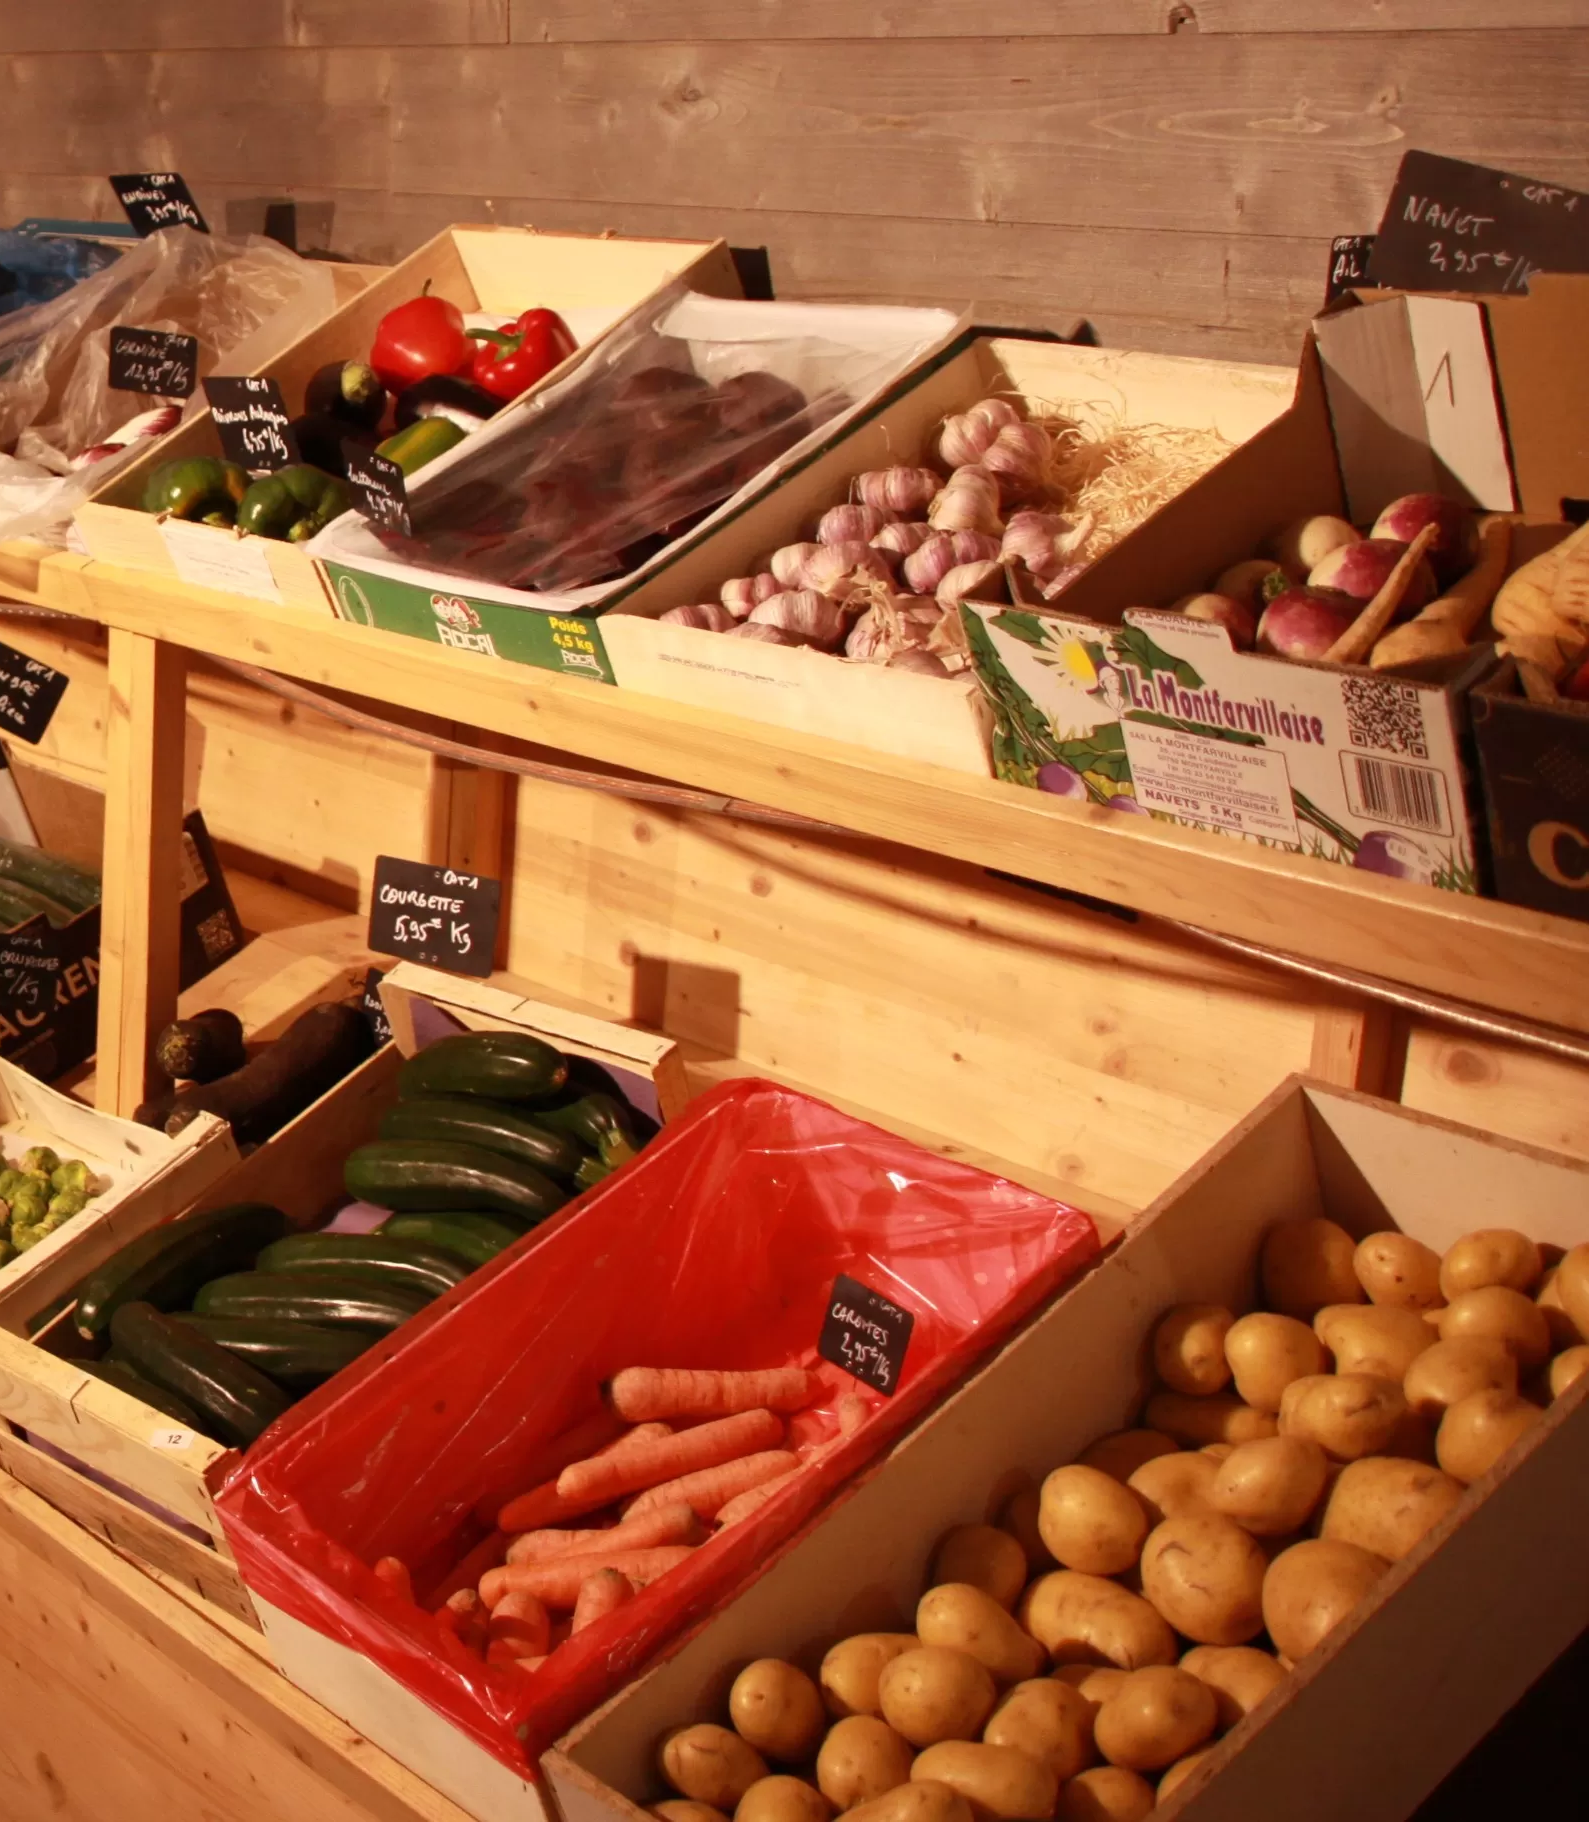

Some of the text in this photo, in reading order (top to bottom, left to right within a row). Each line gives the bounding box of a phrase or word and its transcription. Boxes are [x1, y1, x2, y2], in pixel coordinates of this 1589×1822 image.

[1403, 195, 1496, 238] NAVET
[548, 615, 588, 636] Poids
[552, 632, 595, 654] 4,5 kg
[1125, 667, 1325, 746] La Montfarvillaise
[1143, 788, 1201, 811] NAVETS
[1208, 803, 1219, 815] 5
[1221, 806, 1242, 822] Kg
[380, 884, 464, 913] COURGETTE
[451, 921, 472, 954] Kg
[167, 1434, 183, 1445] 12
